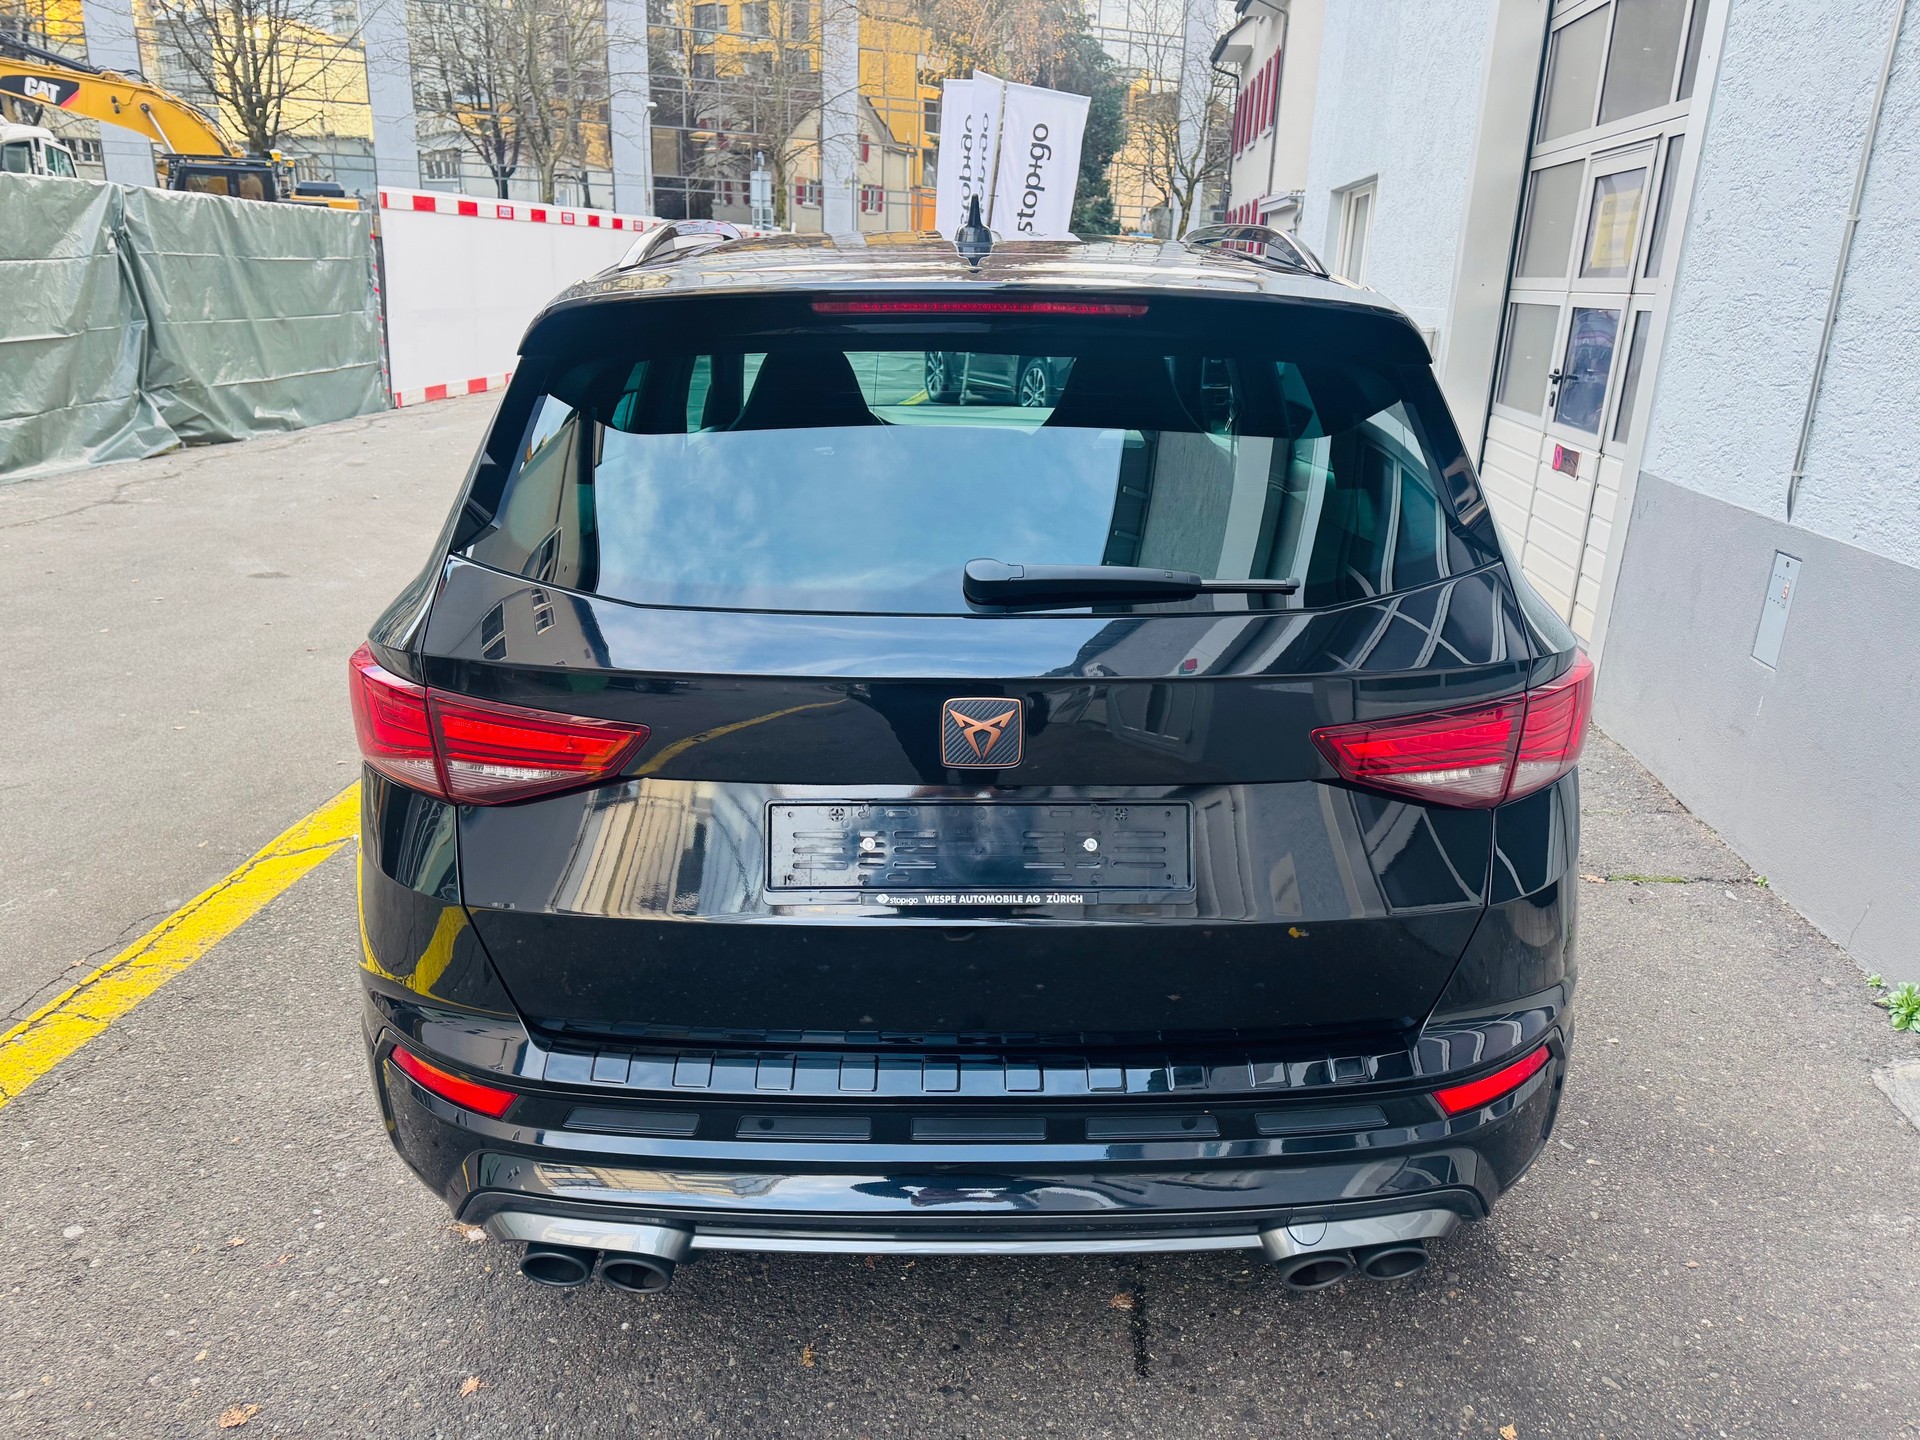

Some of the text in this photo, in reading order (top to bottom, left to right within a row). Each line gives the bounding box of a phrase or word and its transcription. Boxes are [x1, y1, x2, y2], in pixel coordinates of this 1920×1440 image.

[23, 76, 61, 104] CAT
[1017, 122, 1052, 232] stop+go
[924, 894, 958, 904] WESPE
[958, 894, 1023, 904] AUTOMOBILE
[1025, 894, 1041, 904] AG
[1046, 892, 1084, 904] ZÜRICH
